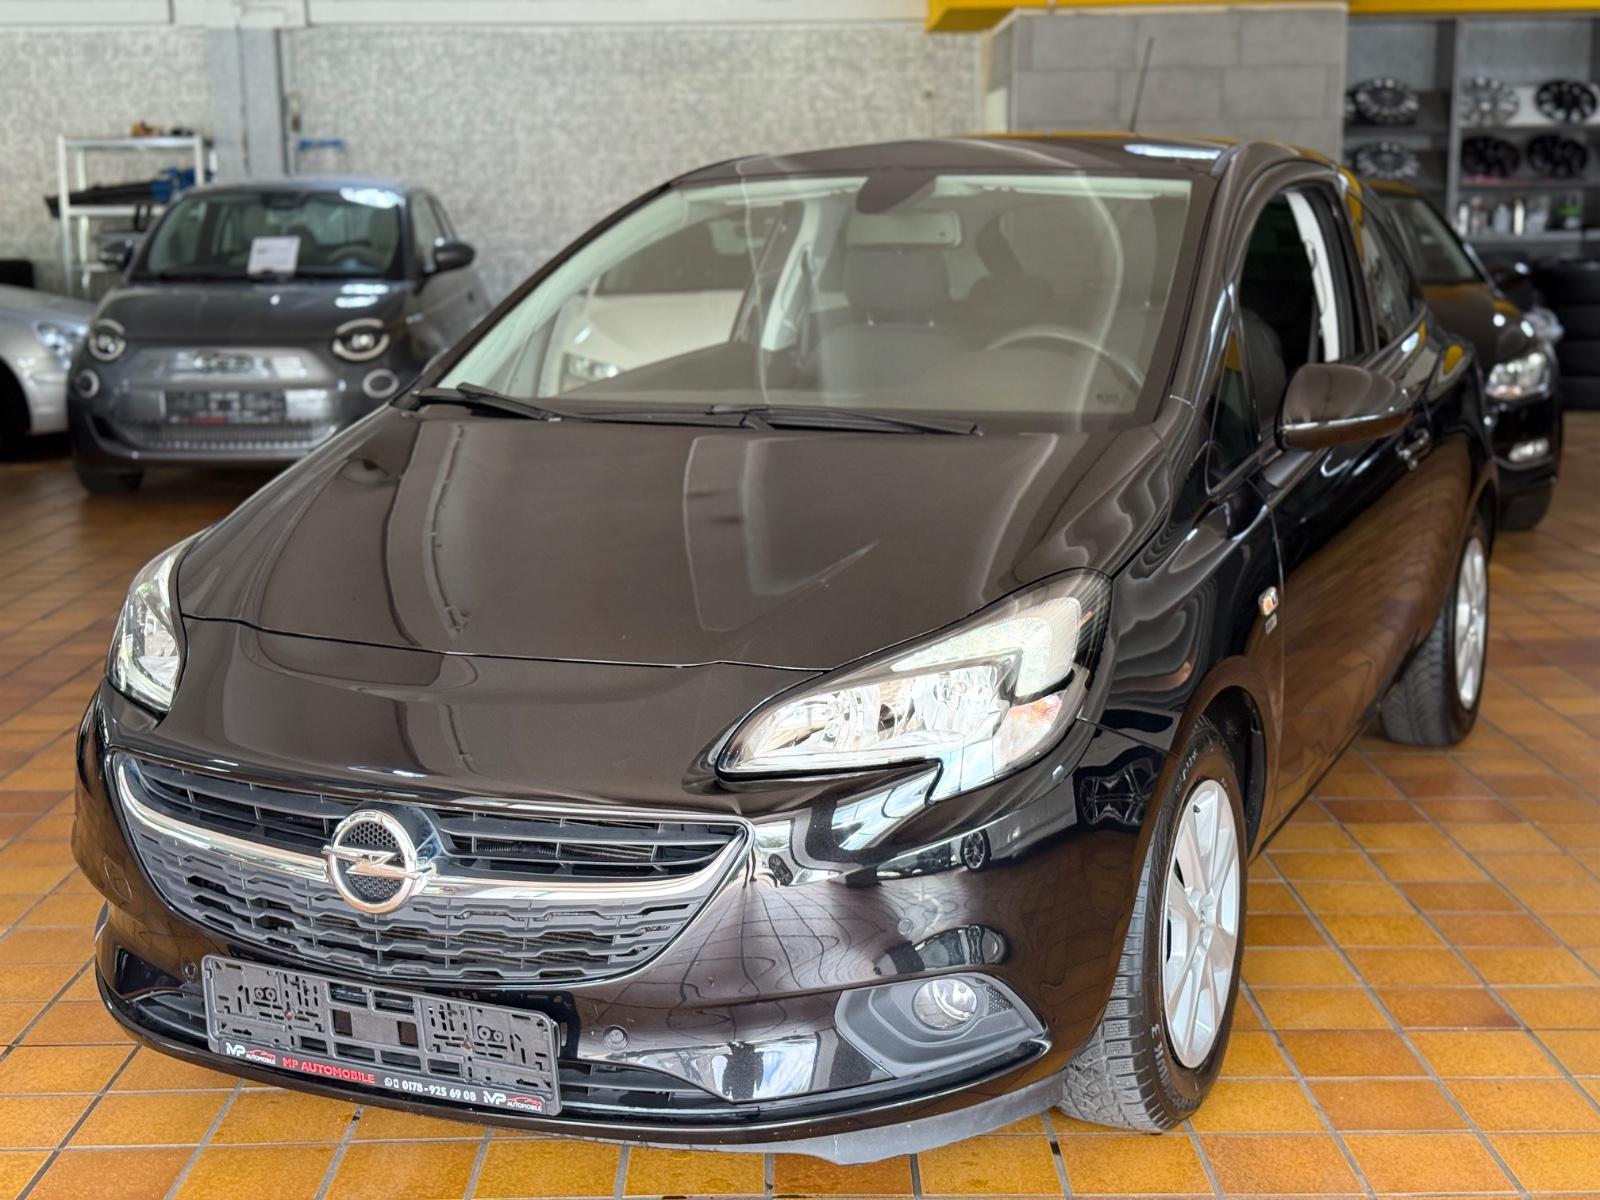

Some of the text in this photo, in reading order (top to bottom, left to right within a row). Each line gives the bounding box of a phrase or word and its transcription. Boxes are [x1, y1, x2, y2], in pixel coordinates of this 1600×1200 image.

[225, 1042, 276, 1065] MP AUTOMOBILE
[282, 1057, 375, 1084] MP AUTOMOBILE
[402, 1080, 476, 1101] 0178-925 69 08
[483, 1090, 542, 1112] MP AUTOMOBILE
